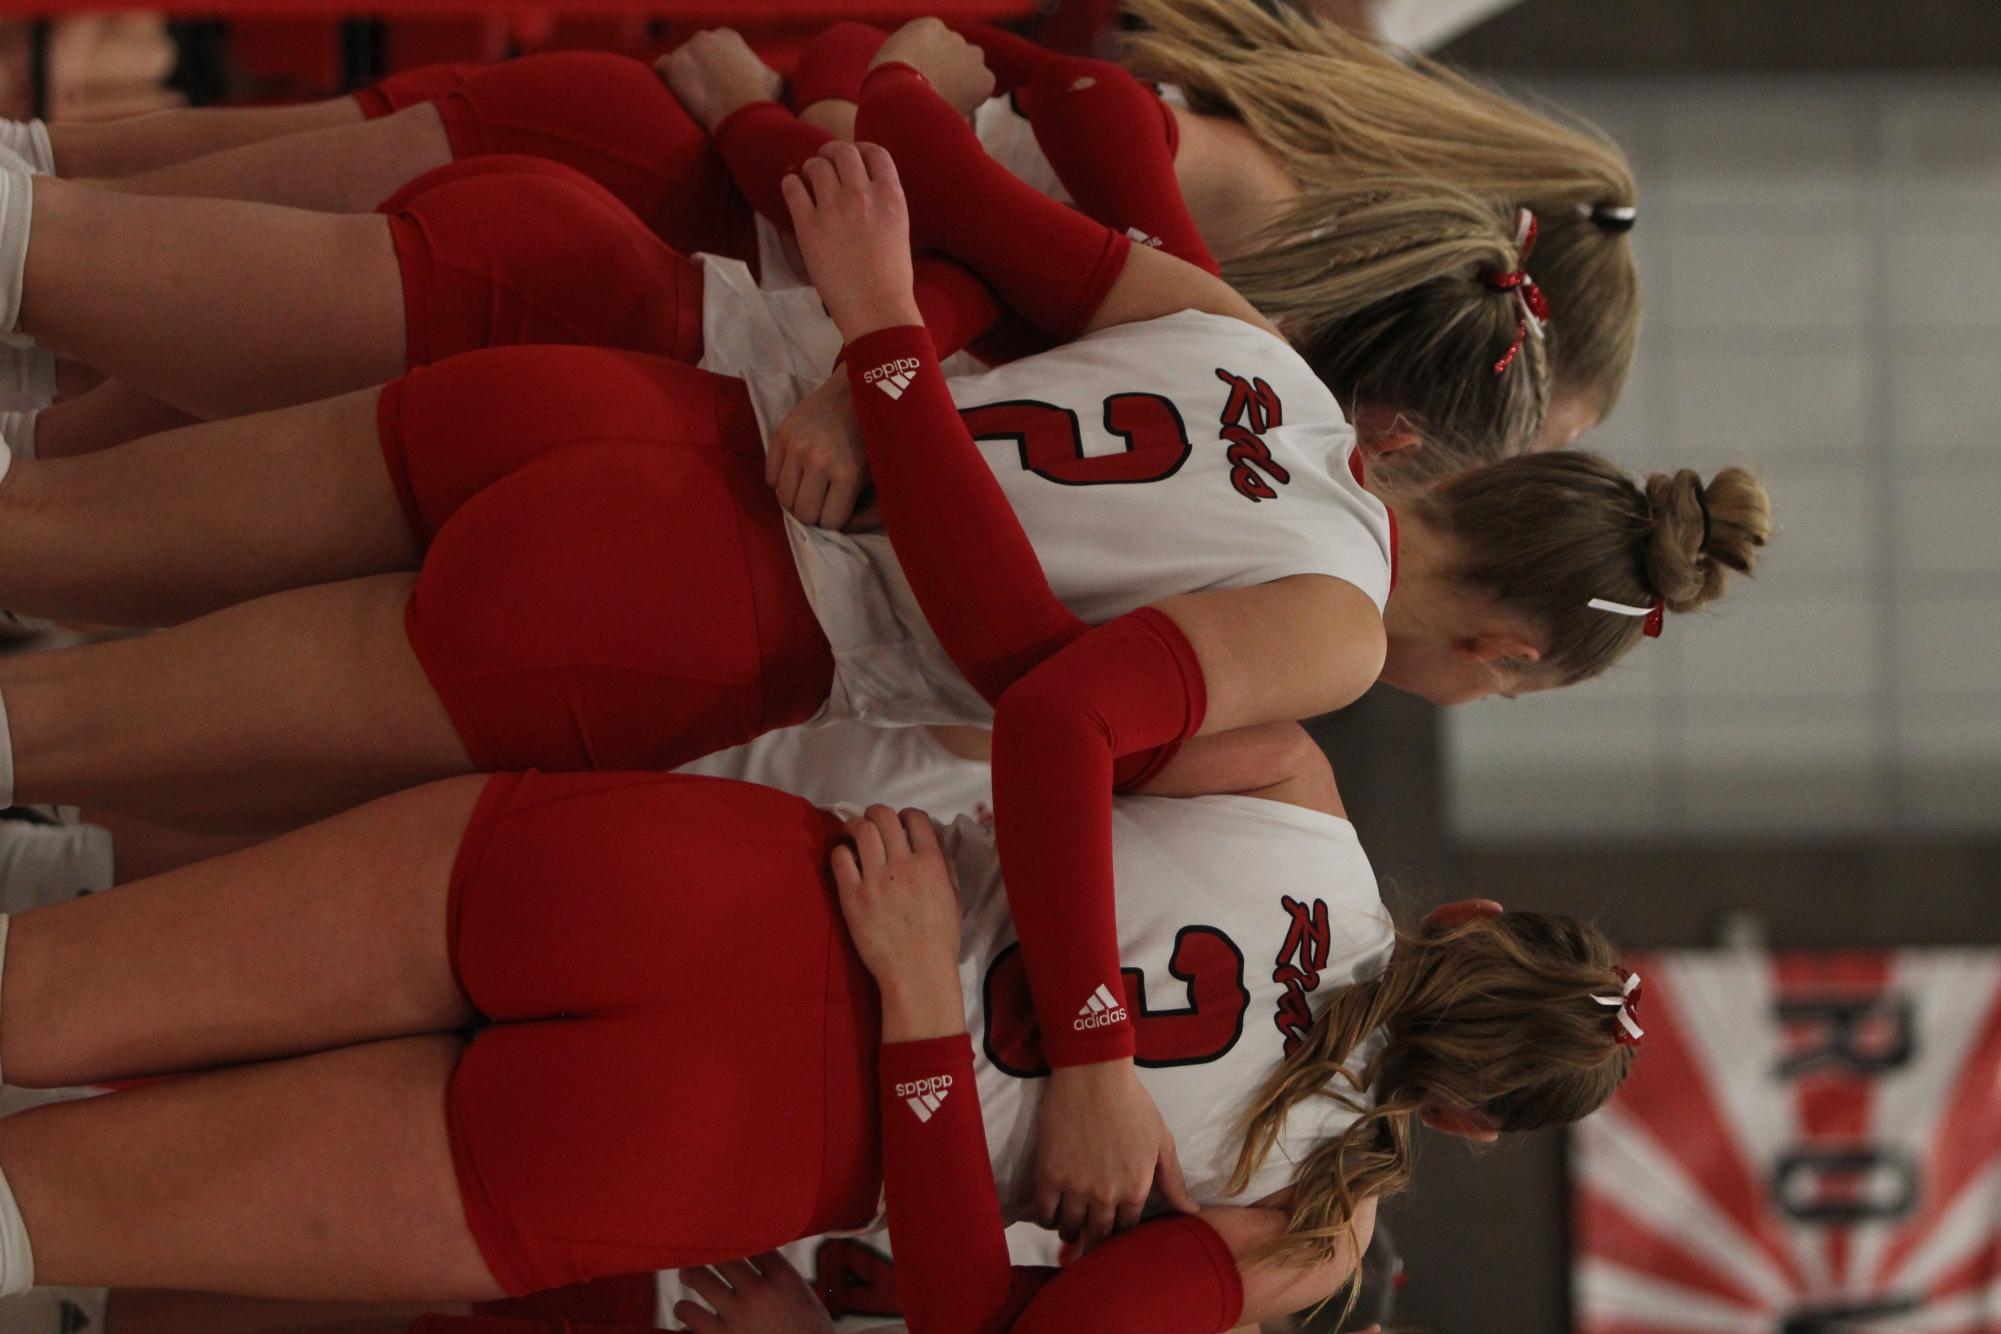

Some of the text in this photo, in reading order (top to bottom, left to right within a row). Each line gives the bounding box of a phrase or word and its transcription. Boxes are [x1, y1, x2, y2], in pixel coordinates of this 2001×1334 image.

[863, 358, 919, 383] adidas
[957, 393, 1192, 486] 2
[1073, 1008, 1125, 1030] adidas
[895, 1075, 951, 1096] adidas
[1773, 988, 1920, 1334] RO
